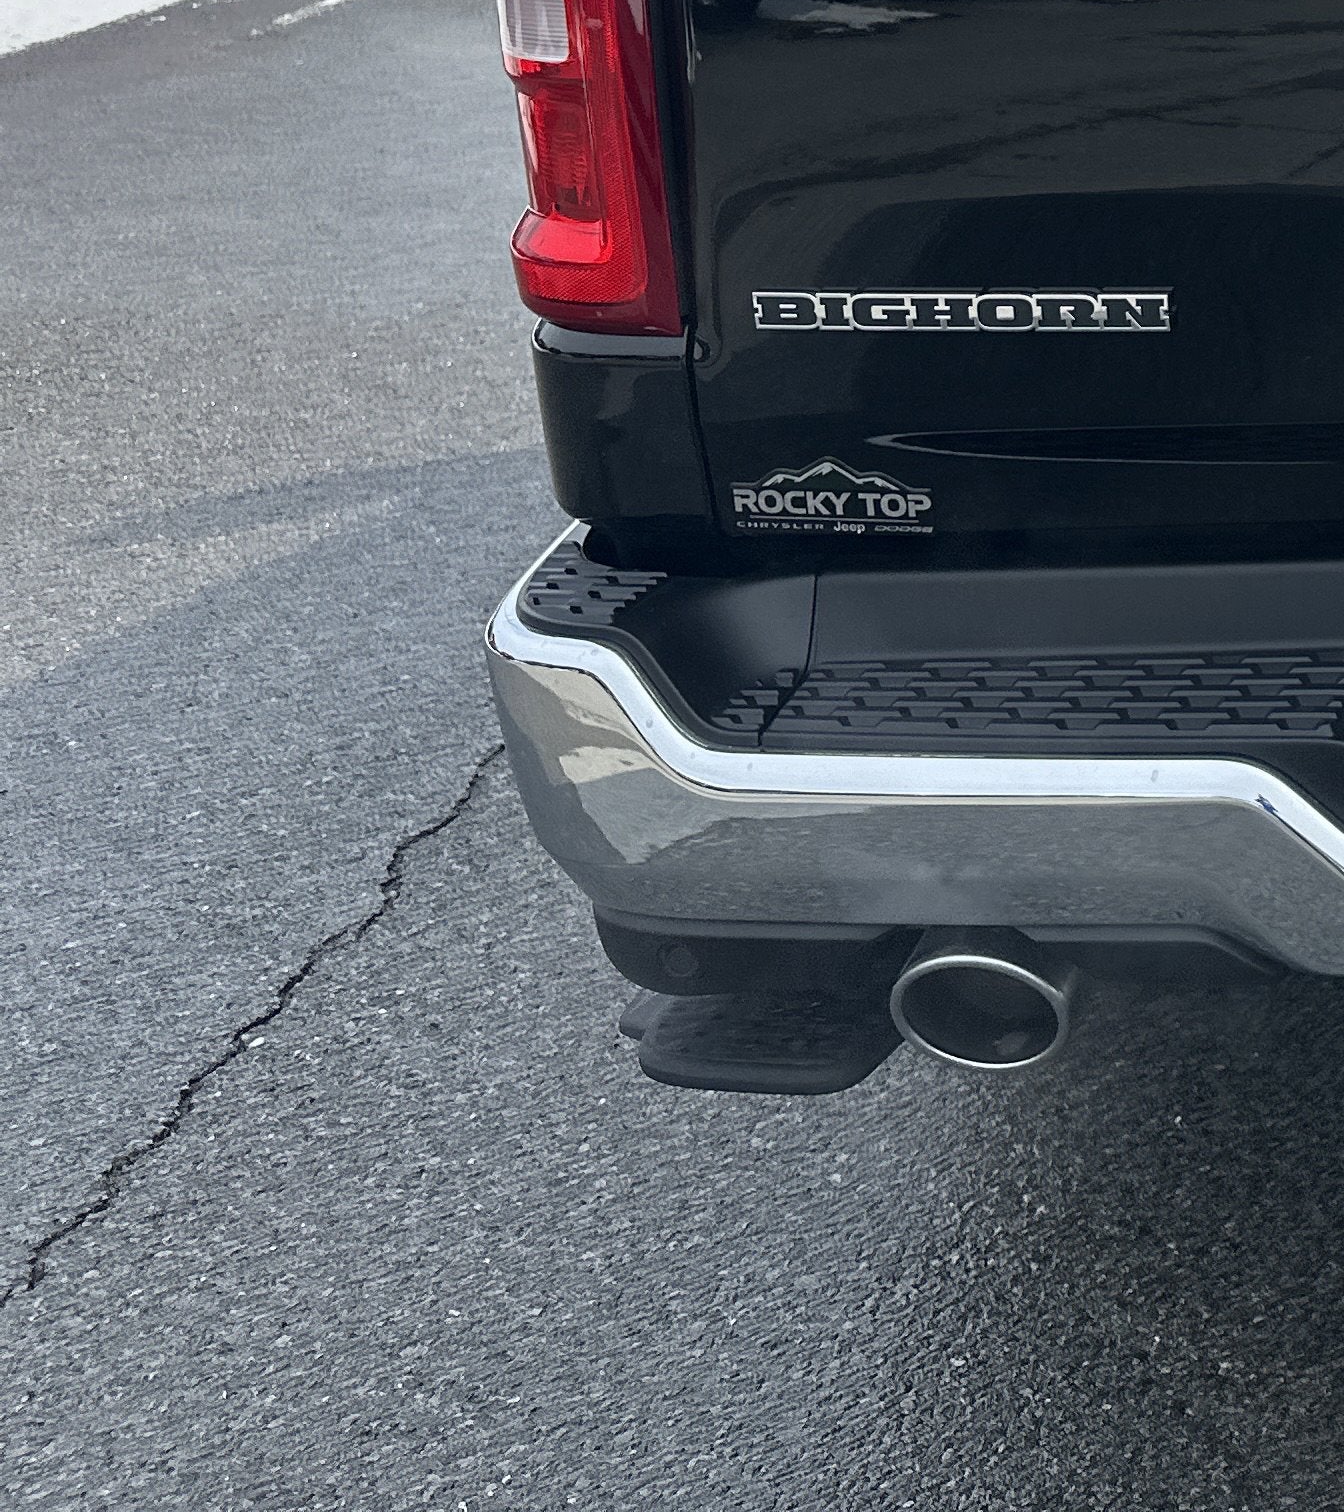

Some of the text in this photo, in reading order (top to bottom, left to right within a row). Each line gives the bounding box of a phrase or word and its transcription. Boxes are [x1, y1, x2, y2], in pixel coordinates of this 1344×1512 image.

[751, 291, 1172, 332] BIGHORN
[732, 488, 932, 518] ROCKY TOP
[736, 520, 934, 534] CHRYSLER Jeep DODGE
